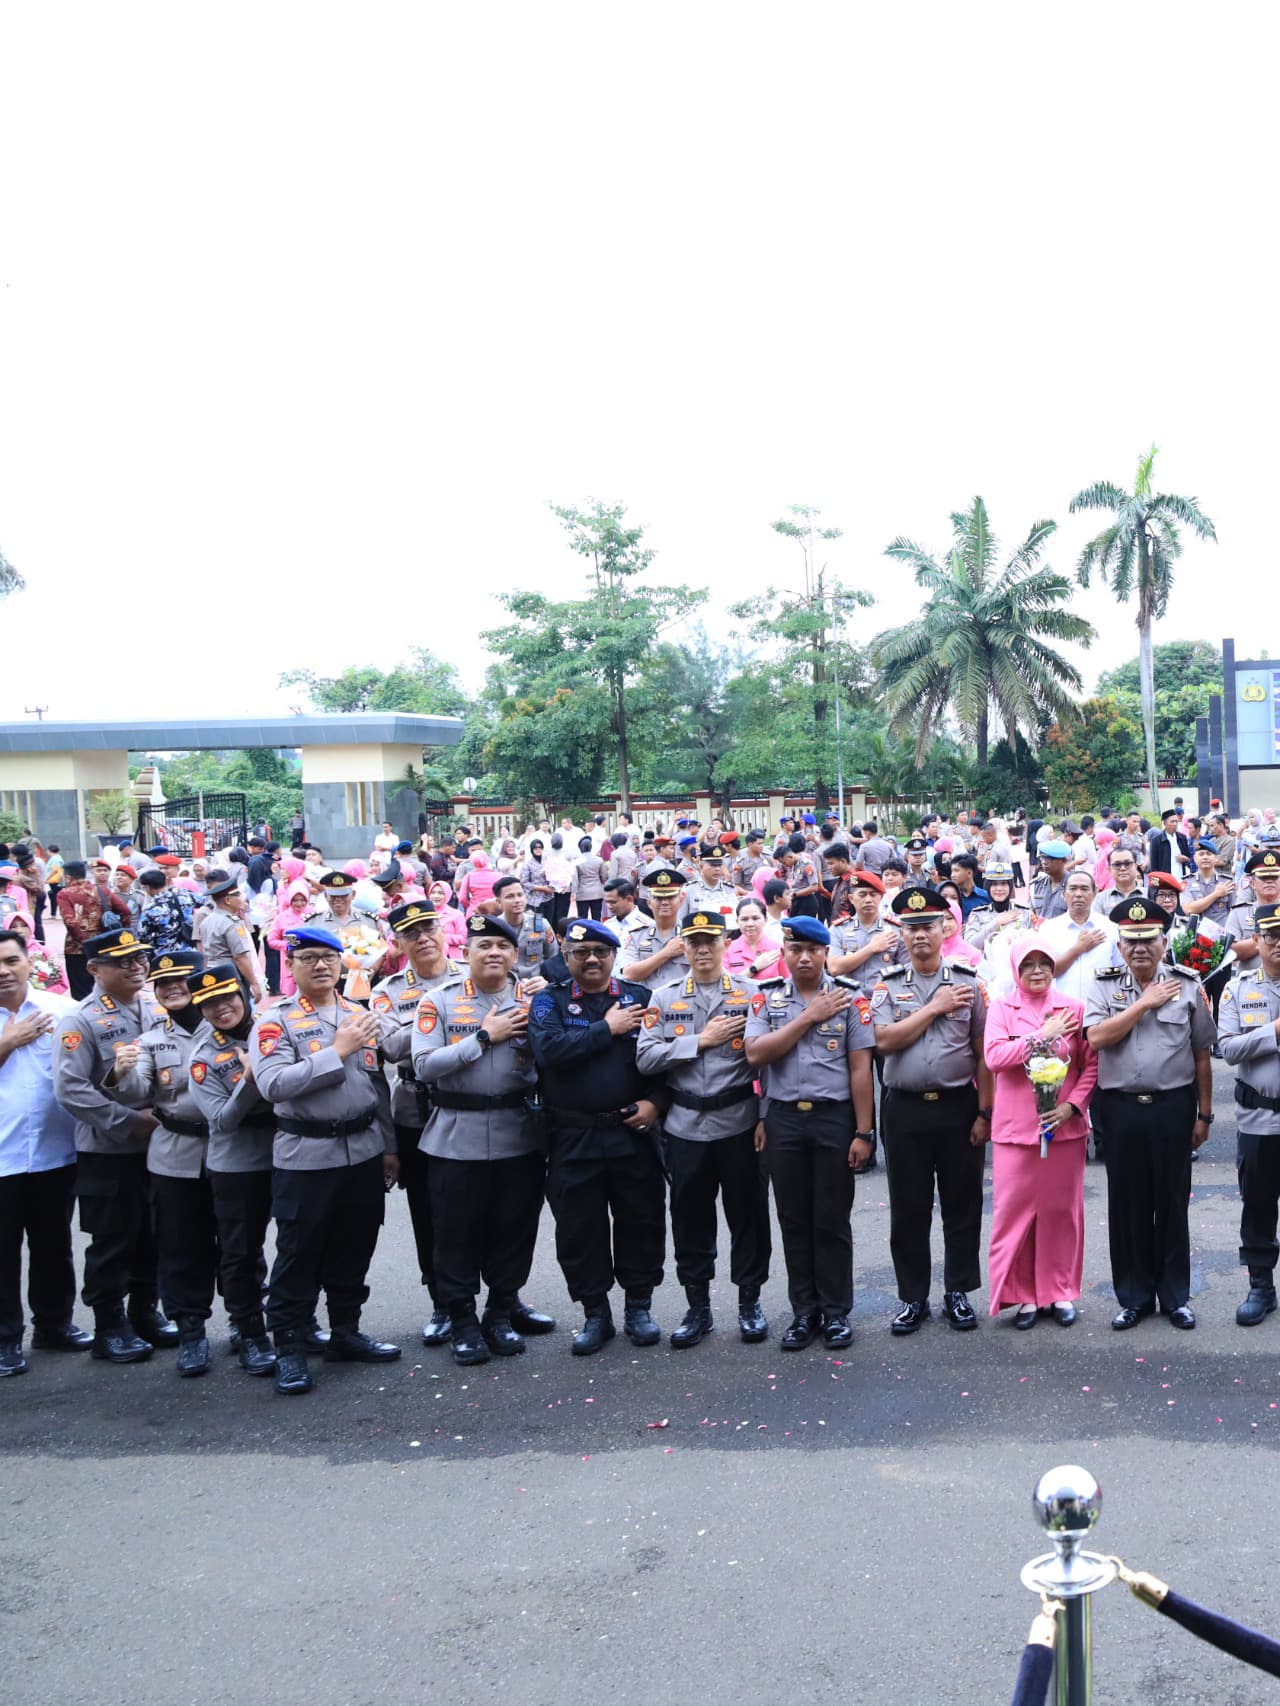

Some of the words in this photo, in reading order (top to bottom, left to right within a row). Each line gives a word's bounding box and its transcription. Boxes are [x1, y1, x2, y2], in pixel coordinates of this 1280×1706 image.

[1241, 1001, 1268, 1010] HENDRA
[665, 1013, 694, 1022] DARWIS
[448, 1024, 482, 1033] KUKUH
[295, 1028, 324, 1040] YUNUS
[149, 1043, 178, 1053] WIDYA
